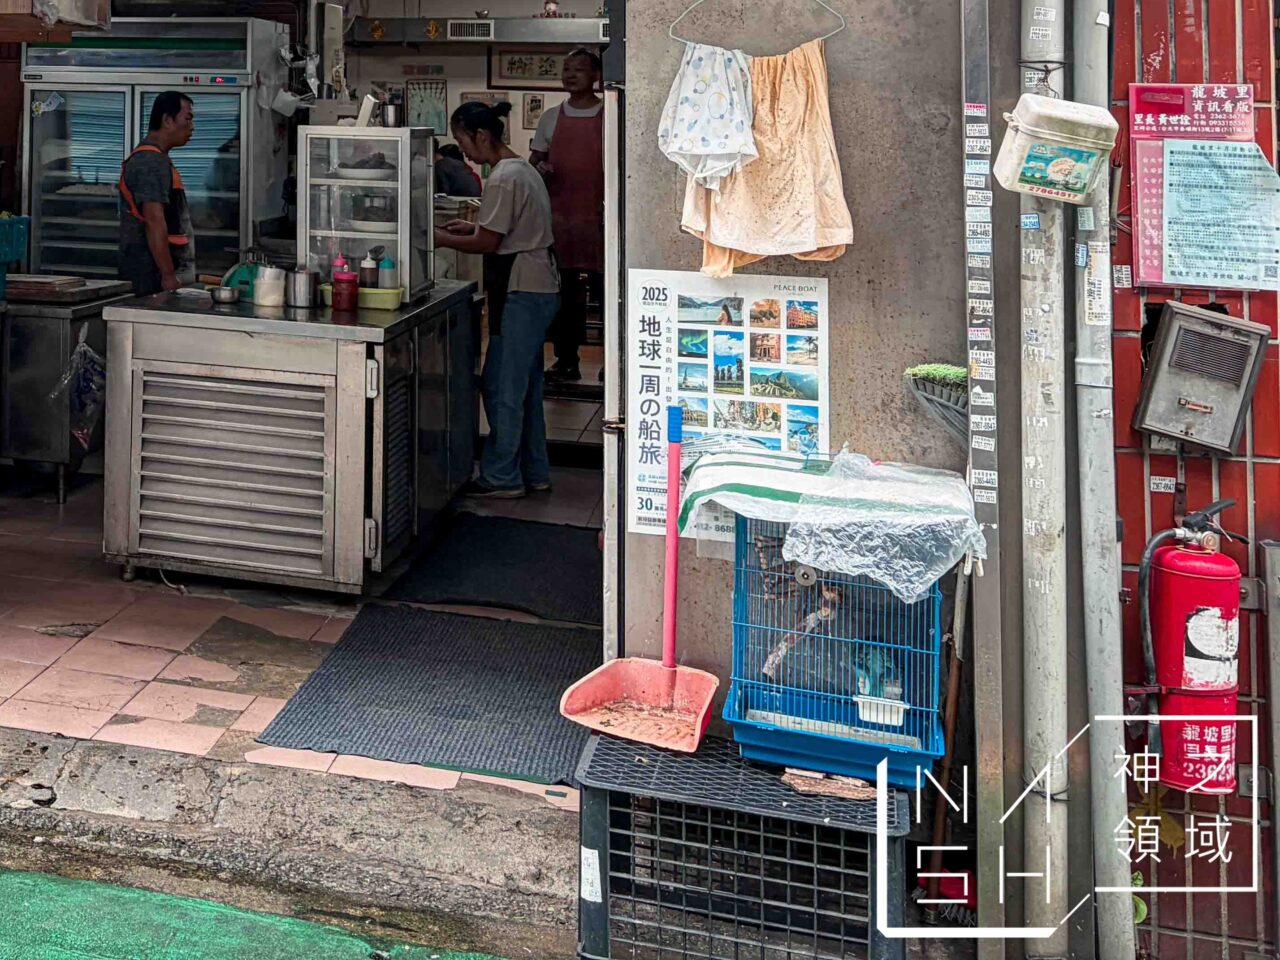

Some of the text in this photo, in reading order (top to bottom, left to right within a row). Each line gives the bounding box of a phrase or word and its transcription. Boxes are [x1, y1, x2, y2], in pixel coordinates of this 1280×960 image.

[1191, 85, 1250, 99] 龍坡里
[1192, 100, 1250, 113] 資訊看版
[642, 286, 668, 302] 2025
[773, 284, 797, 292] PEACE
[638, 314, 662, 465] 地球一周の船旅
[637, 496, 653, 511] 30
